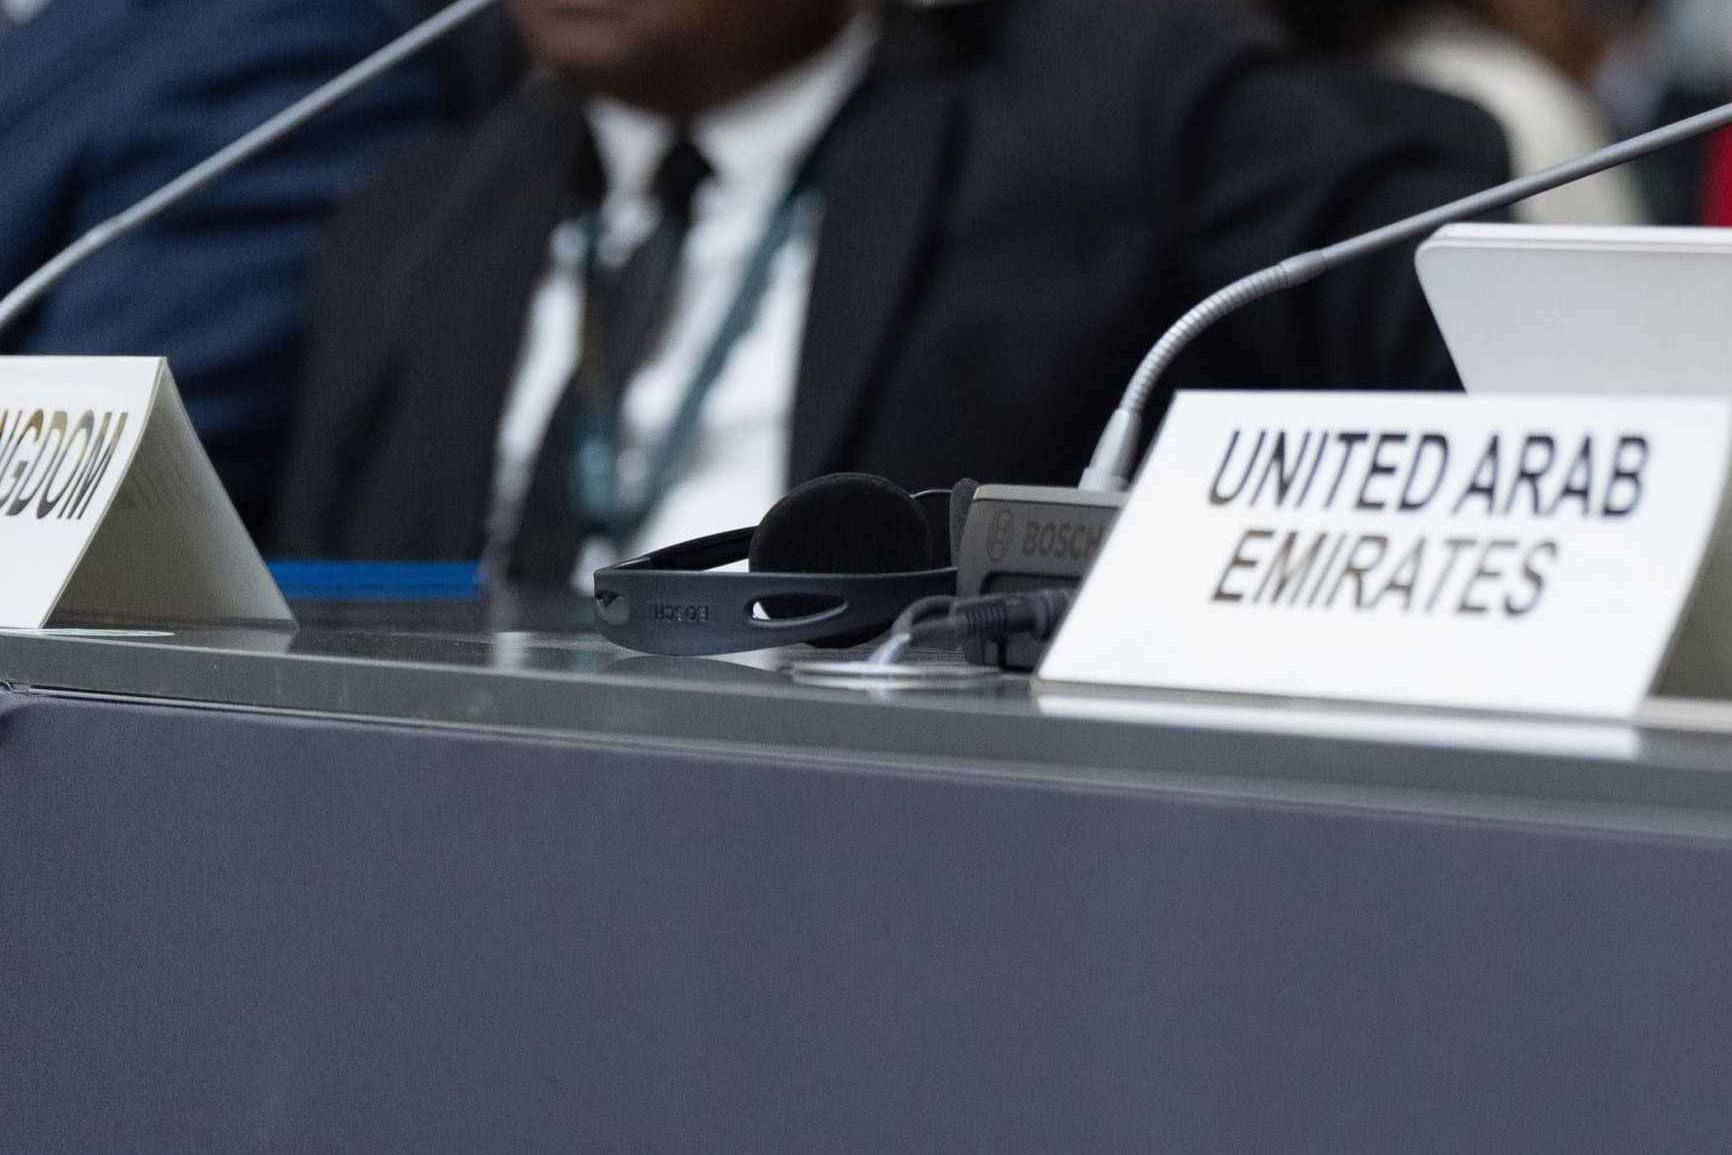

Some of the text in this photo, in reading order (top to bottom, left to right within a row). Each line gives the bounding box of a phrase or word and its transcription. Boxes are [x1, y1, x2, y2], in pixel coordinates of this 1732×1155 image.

[1207, 430, 1649, 518] UNITED ARAB
[1022, 521, 1106, 560] BOSCH
[1209, 529, 1559, 616] EMIRATES
